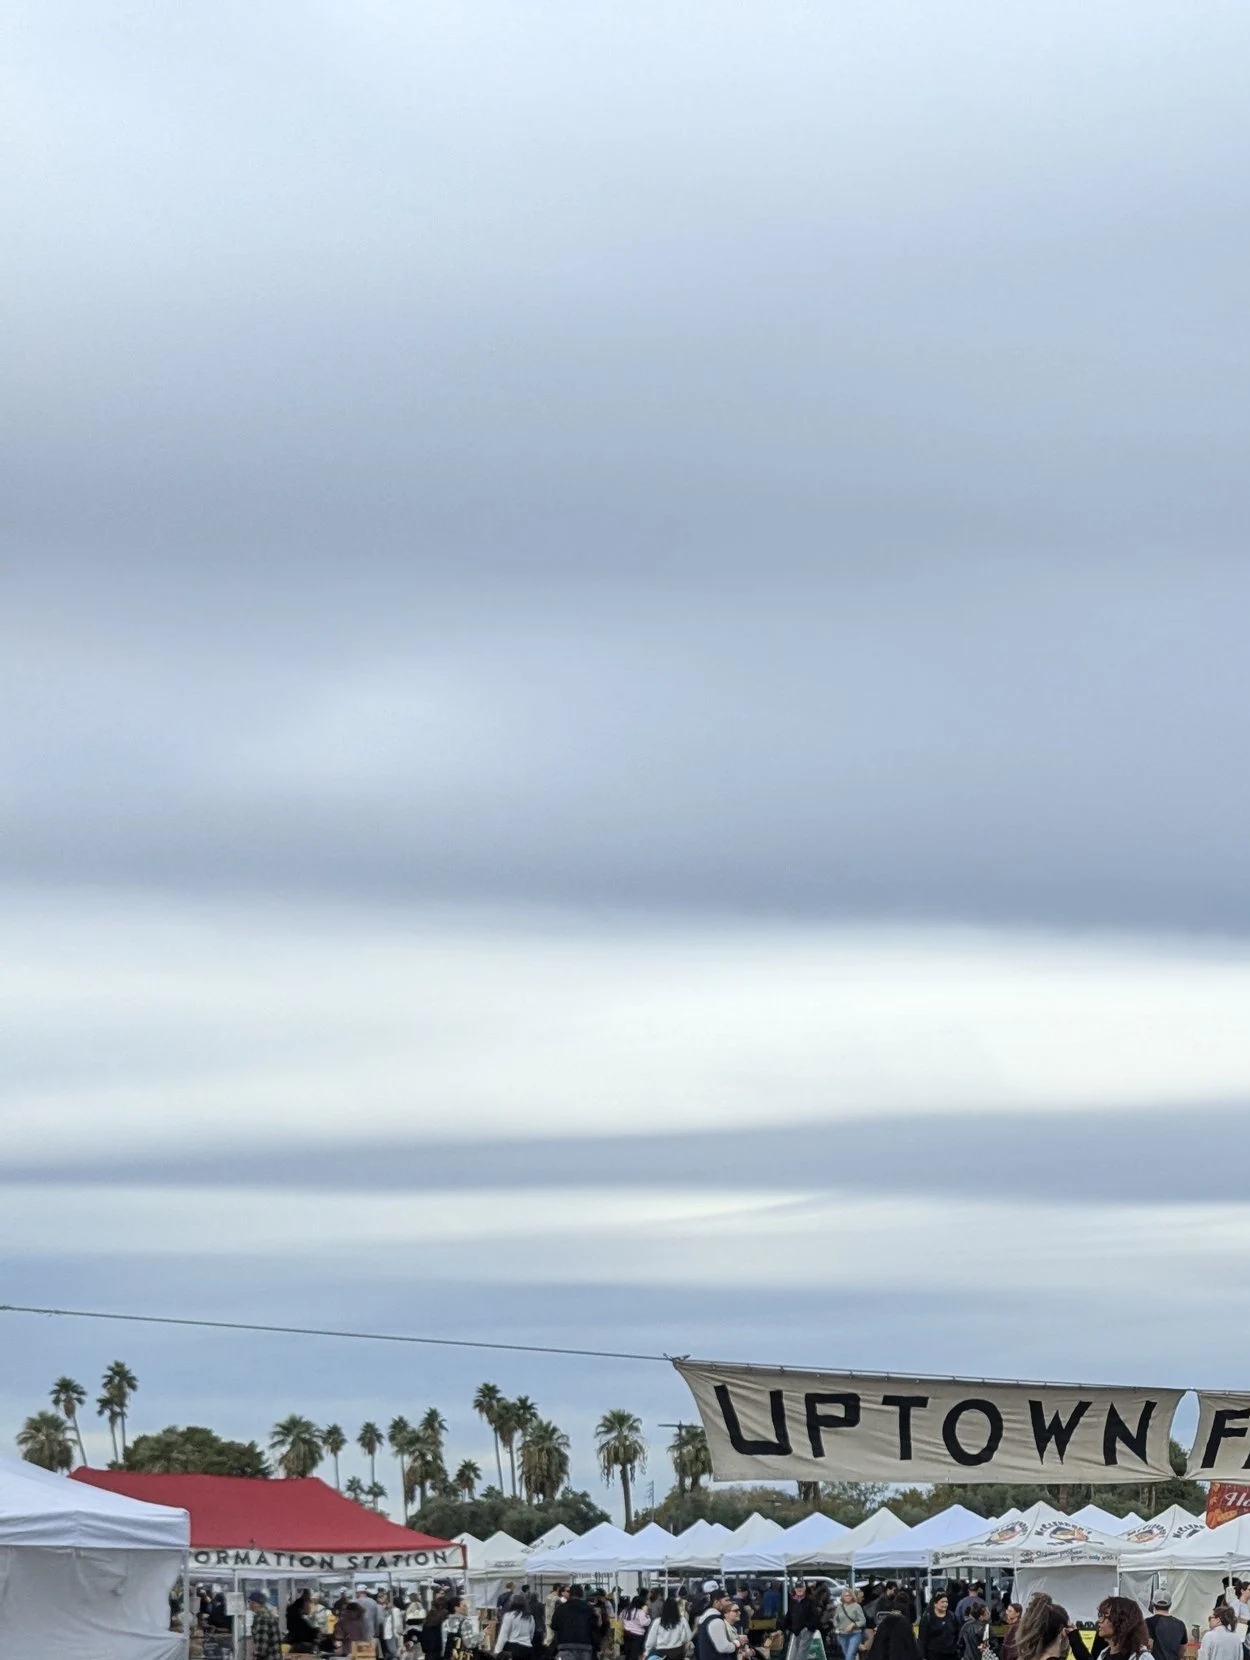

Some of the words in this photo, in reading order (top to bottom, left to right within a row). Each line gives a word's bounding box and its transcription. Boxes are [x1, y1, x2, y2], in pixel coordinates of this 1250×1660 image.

[713, 1384, 1158, 1467] UPTOWN
[192, 1550, 335, 1570] ORMATION
[347, 1550, 449, 1571] STATION
